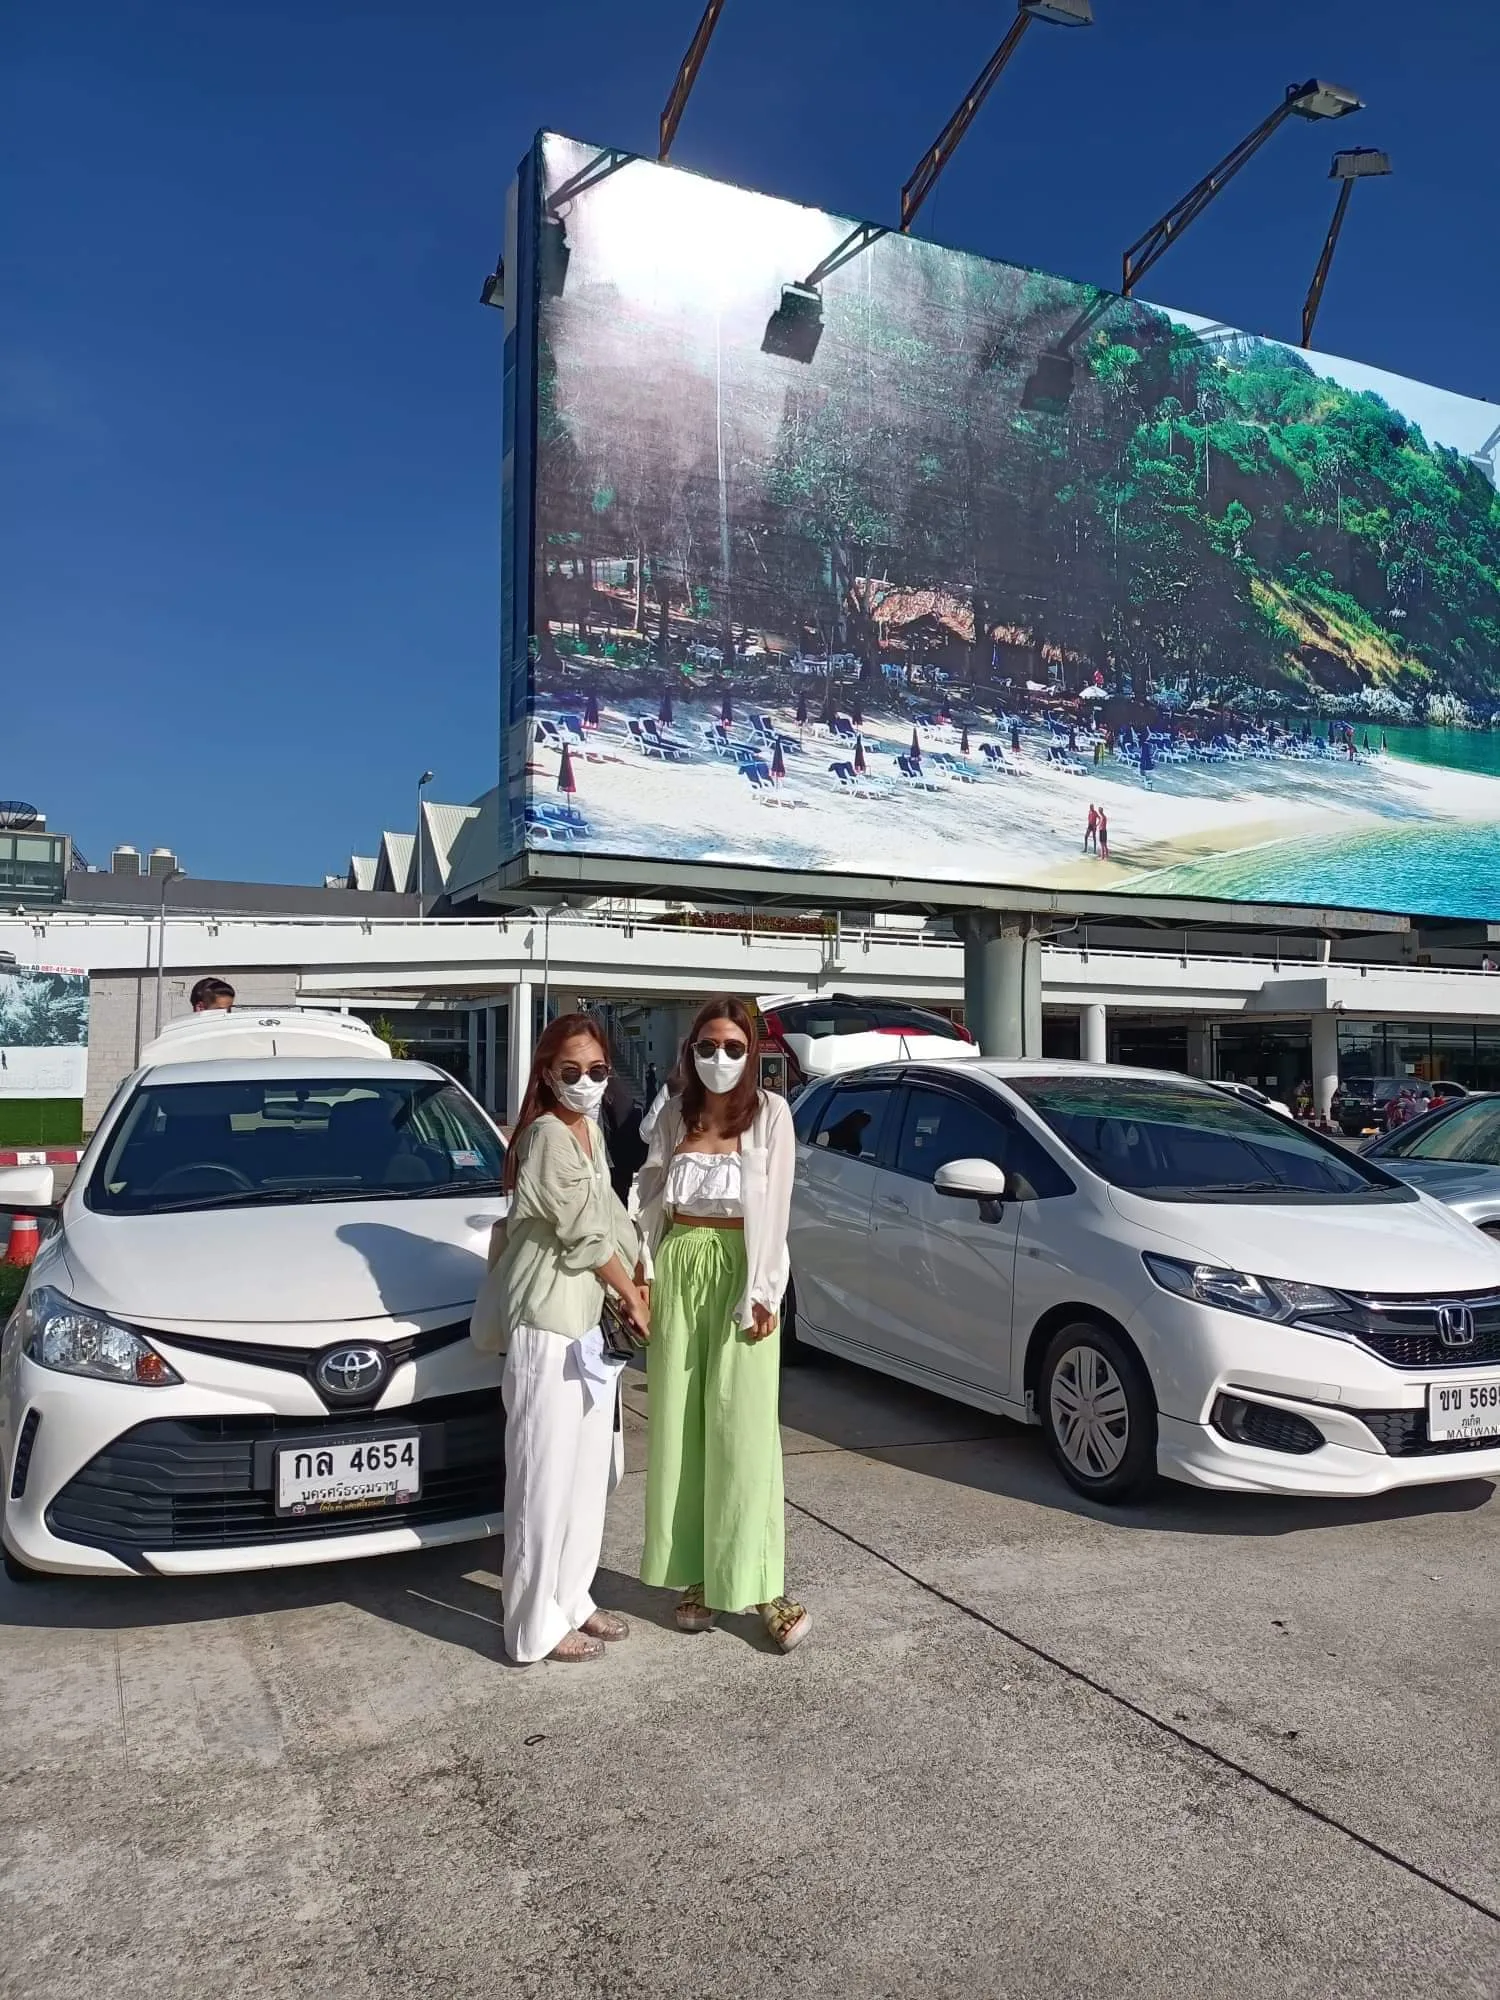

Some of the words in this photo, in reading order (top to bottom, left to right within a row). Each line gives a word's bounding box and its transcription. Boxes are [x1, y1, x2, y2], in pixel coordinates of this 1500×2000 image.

[1440, 1389, 1462, 1411] ขข
[1470, 1386, 1500, 1408] 569
[1446, 1425, 1498, 1439] MALIWAN
[294, 1451, 334, 1479] กล
[350, 1442, 415, 1472] 4654
[301, 1479, 399, 1501] นครศรีธรรมราช
